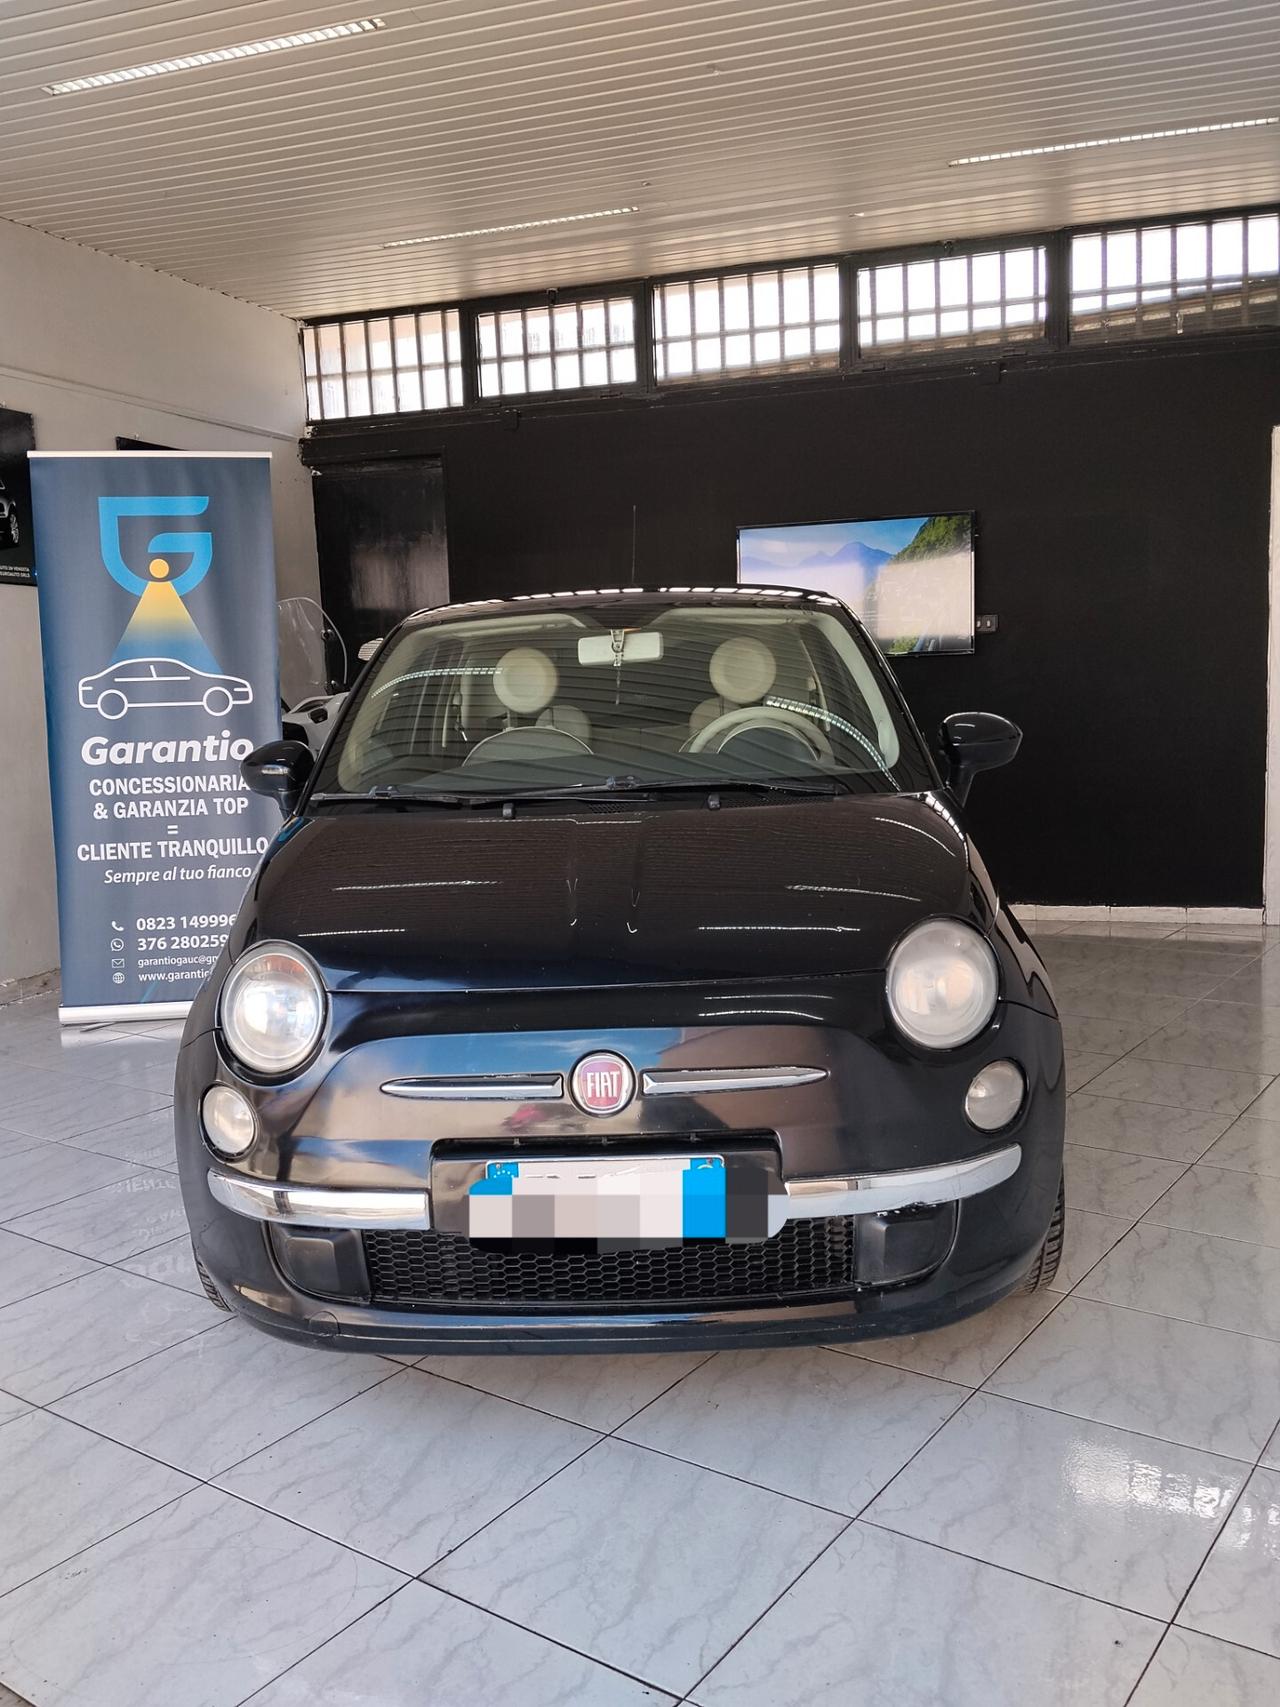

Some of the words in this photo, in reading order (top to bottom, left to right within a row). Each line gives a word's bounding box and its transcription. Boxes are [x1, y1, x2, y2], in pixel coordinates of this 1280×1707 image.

[81, 729, 254, 766] Garantio
[89, 774, 251, 796] CONCESSIONARIA
[93, 802, 108, 819] &
[113, 799, 209, 818] GARANZIA
[213, 797, 249, 815] TOP
[77, 841, 152, 861] CLIENTE
[157, 837, 269, 860] TRANQUILLO
[104, 868, 160, 885] Sempre
[162, 867, 178, 881] al
[179, 867, 204, 880] tuo
[206, 864, 252, 880] fianco
[136, 916, 176, 931] 0823
[180, 913, 237, 929] 149996
[137, 937, 167, 951] 376
[586, 1071, 620, 1098] FIAT
